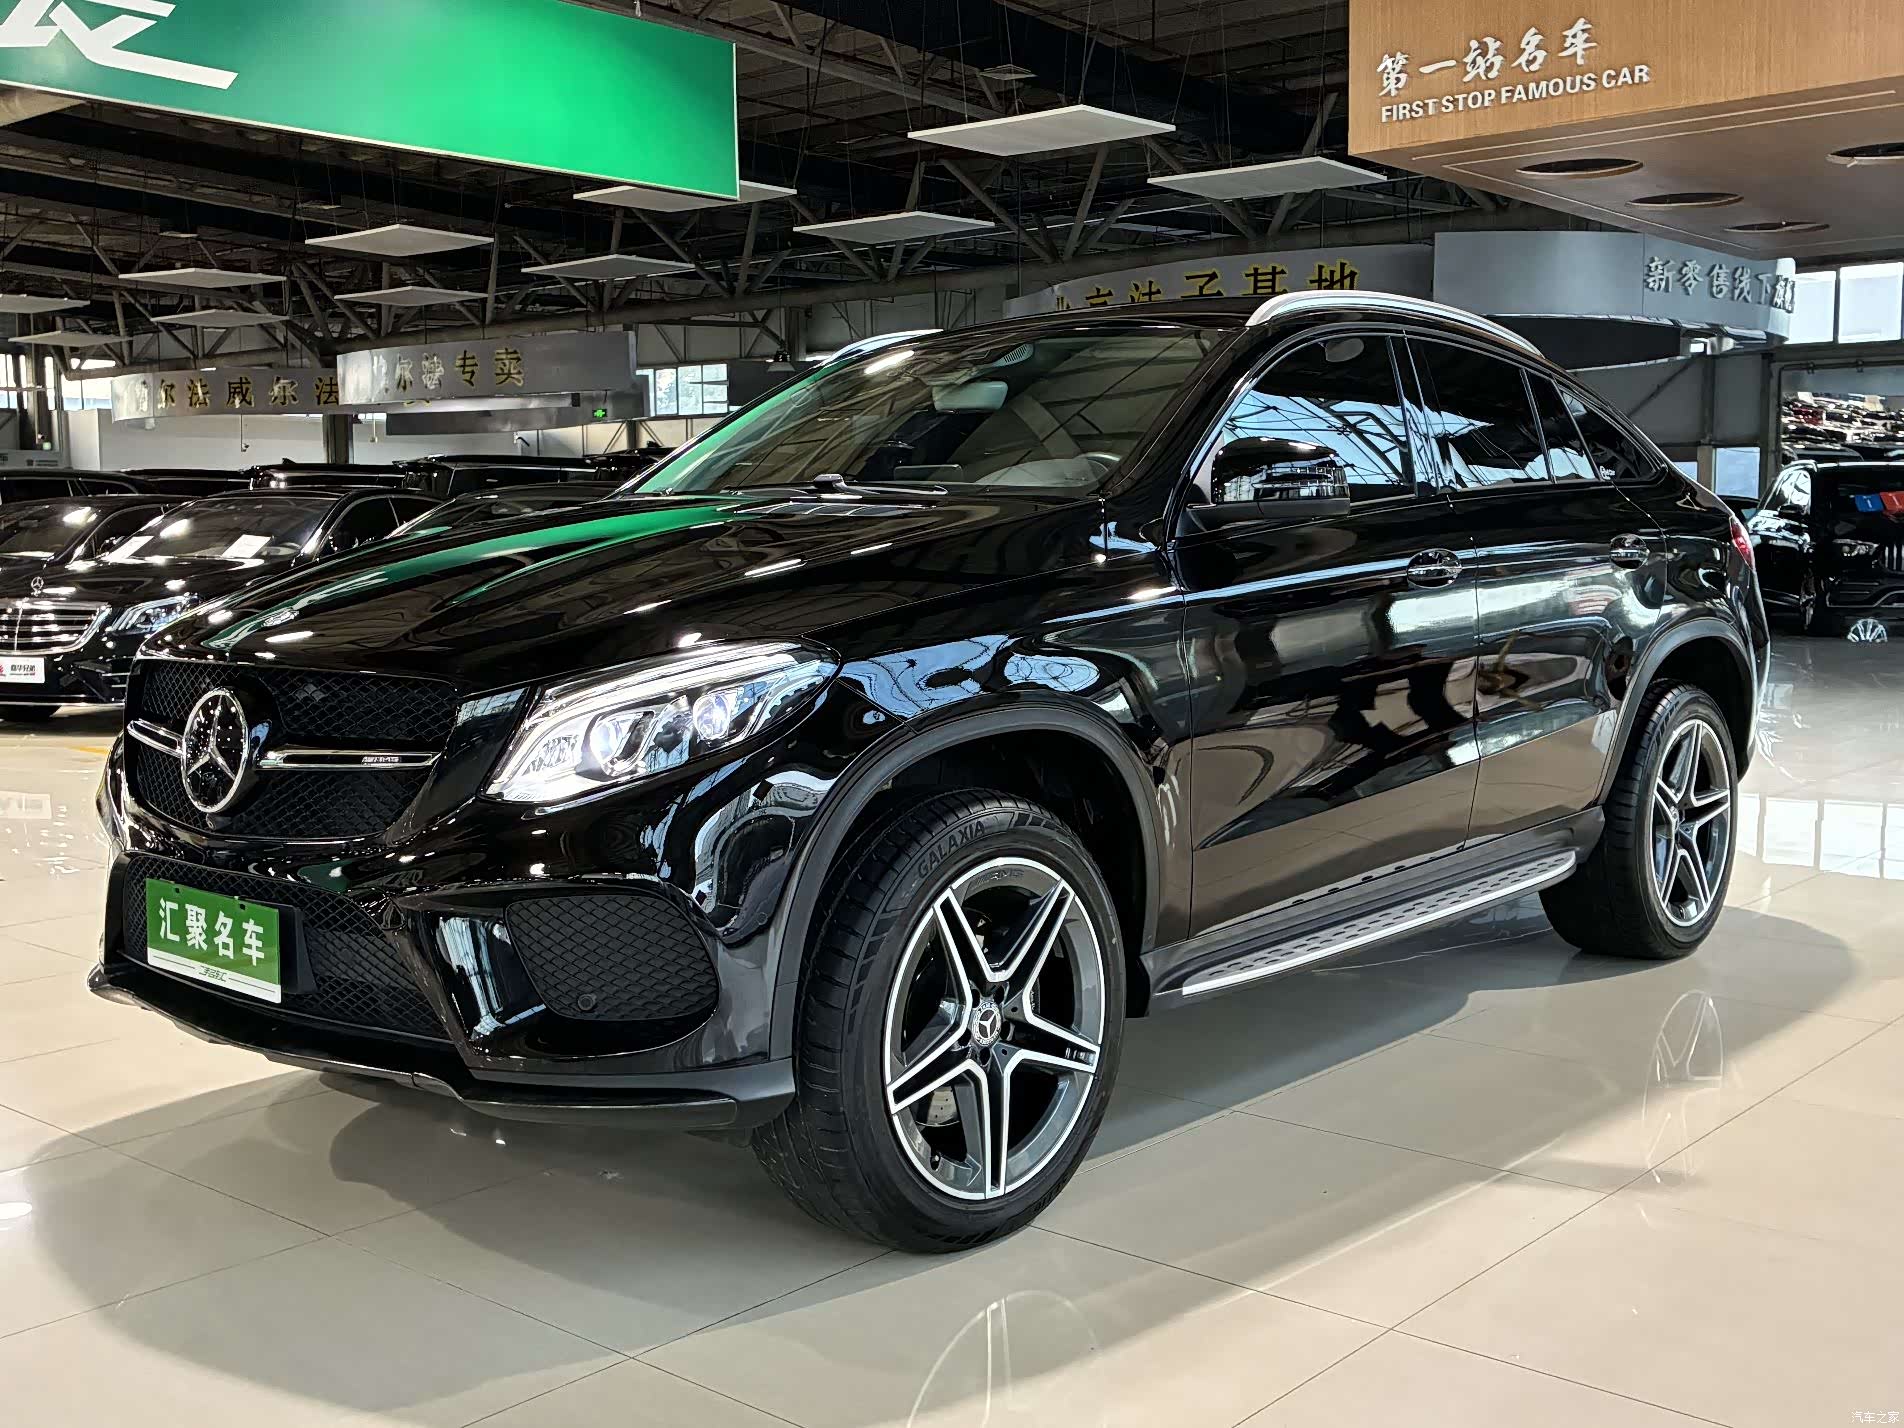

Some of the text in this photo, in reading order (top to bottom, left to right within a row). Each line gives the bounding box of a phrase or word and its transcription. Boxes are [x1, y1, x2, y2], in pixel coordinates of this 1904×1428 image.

[1376, 17, 1598, 97] 第一站名车
[1381, 64, 1651, 123] FIRST STOP FAMOUS CAR
[918, 820, 985, 879] GALAXIA
[159, 897, 264, 966] 汇聚名车
